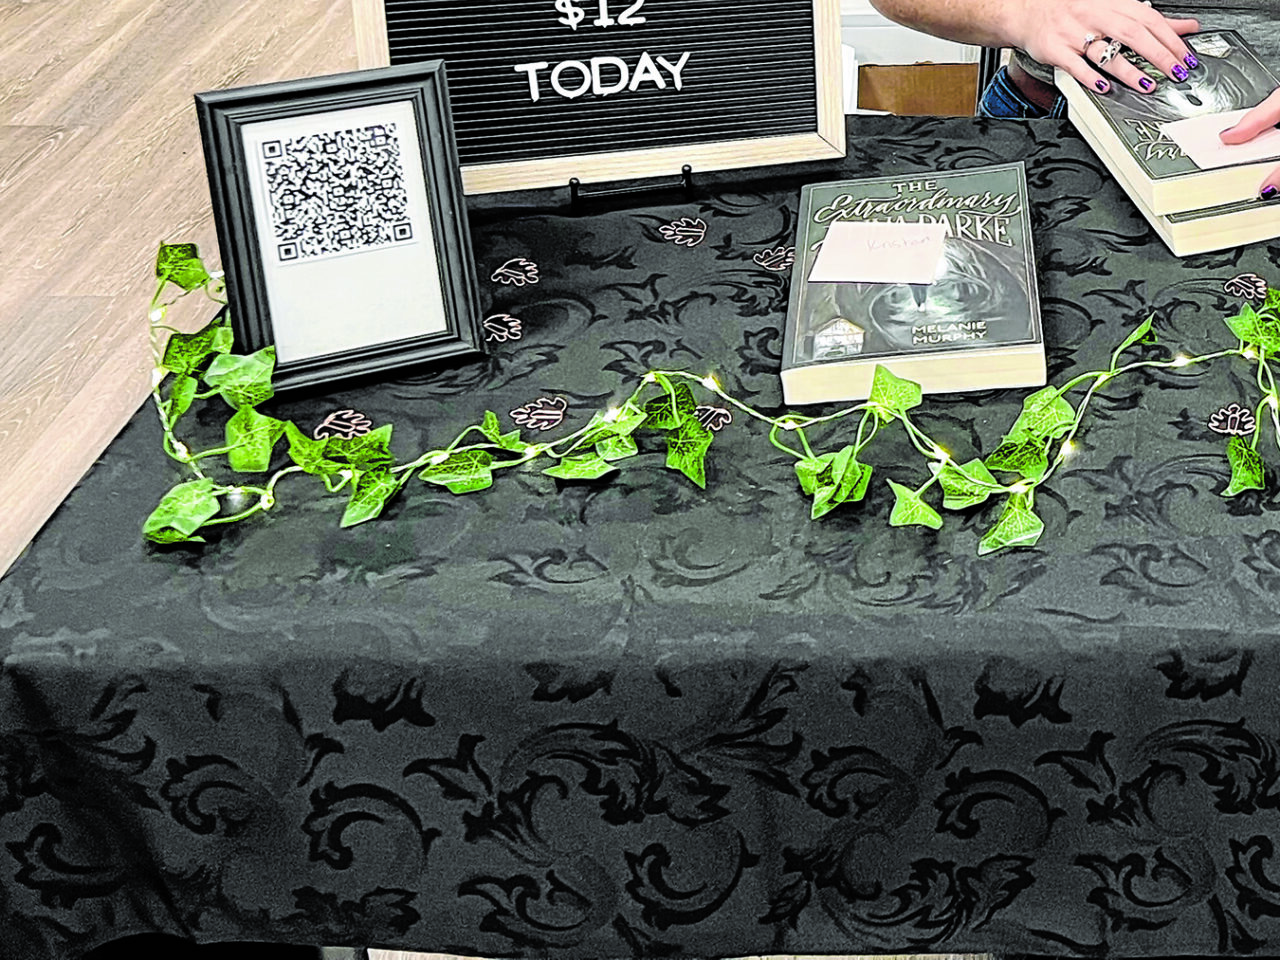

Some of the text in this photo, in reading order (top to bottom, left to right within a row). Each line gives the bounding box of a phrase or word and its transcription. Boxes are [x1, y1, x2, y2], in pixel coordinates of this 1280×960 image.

[514, 50, 692, 104] TODAY
[893, 180, 938, 193] THE
[814, 189, 1022, 224] Extraordinary
[912, 320, 988, 334] MELANIE
[912, 332, 988, 345] MURPHY
